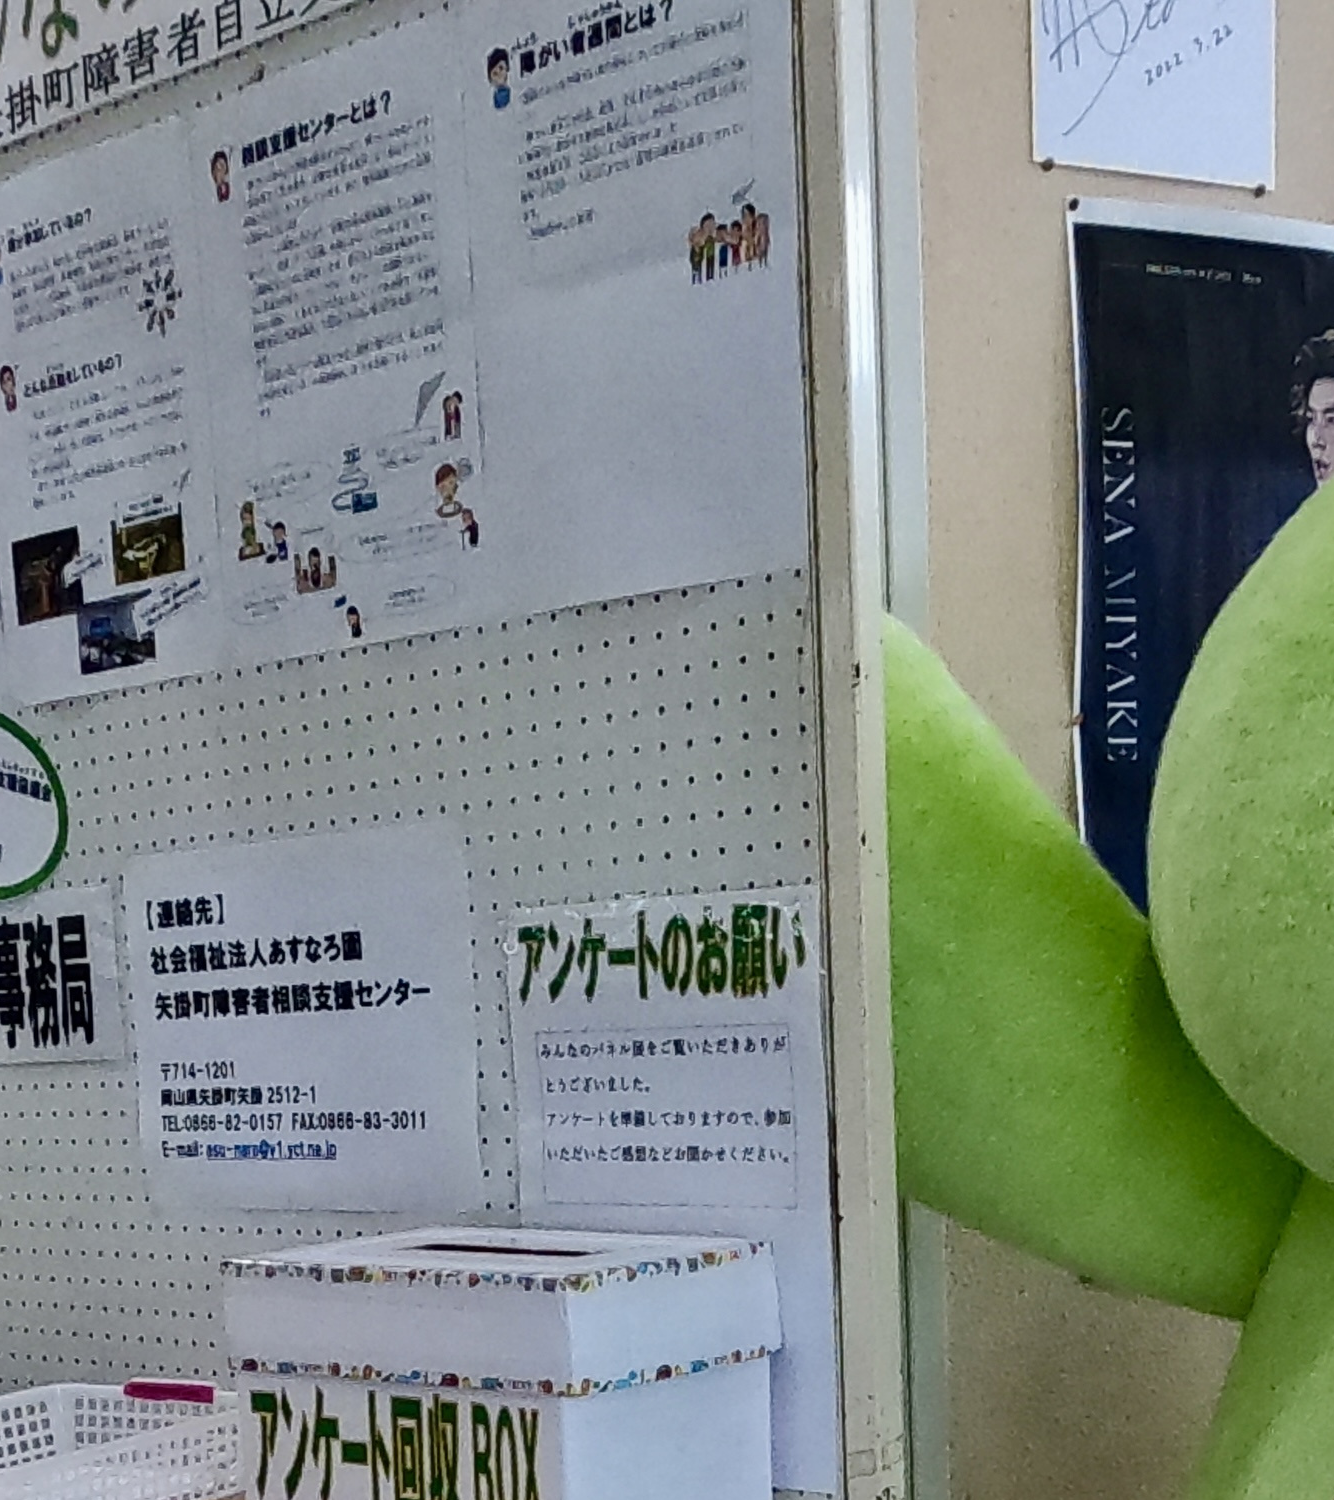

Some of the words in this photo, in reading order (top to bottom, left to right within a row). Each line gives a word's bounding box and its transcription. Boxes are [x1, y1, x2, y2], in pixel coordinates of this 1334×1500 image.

[1101, 406, 1138, 544] SENA
[1104, 566, 1139, 763] MIYAKE
[145, 893, 225, 931] 【連絡先】
[151, 930, 364, 976] 社会福祉法人あすなろ園
[517, 903, 808, 1006] アンケートのお願い
[155, 978, 431, 1021] 矢掛町障害者相談支援センター
[161, 1062, 235, 1082] 〒714-1201
[267, 1086, 316, 1105] 2512-1
